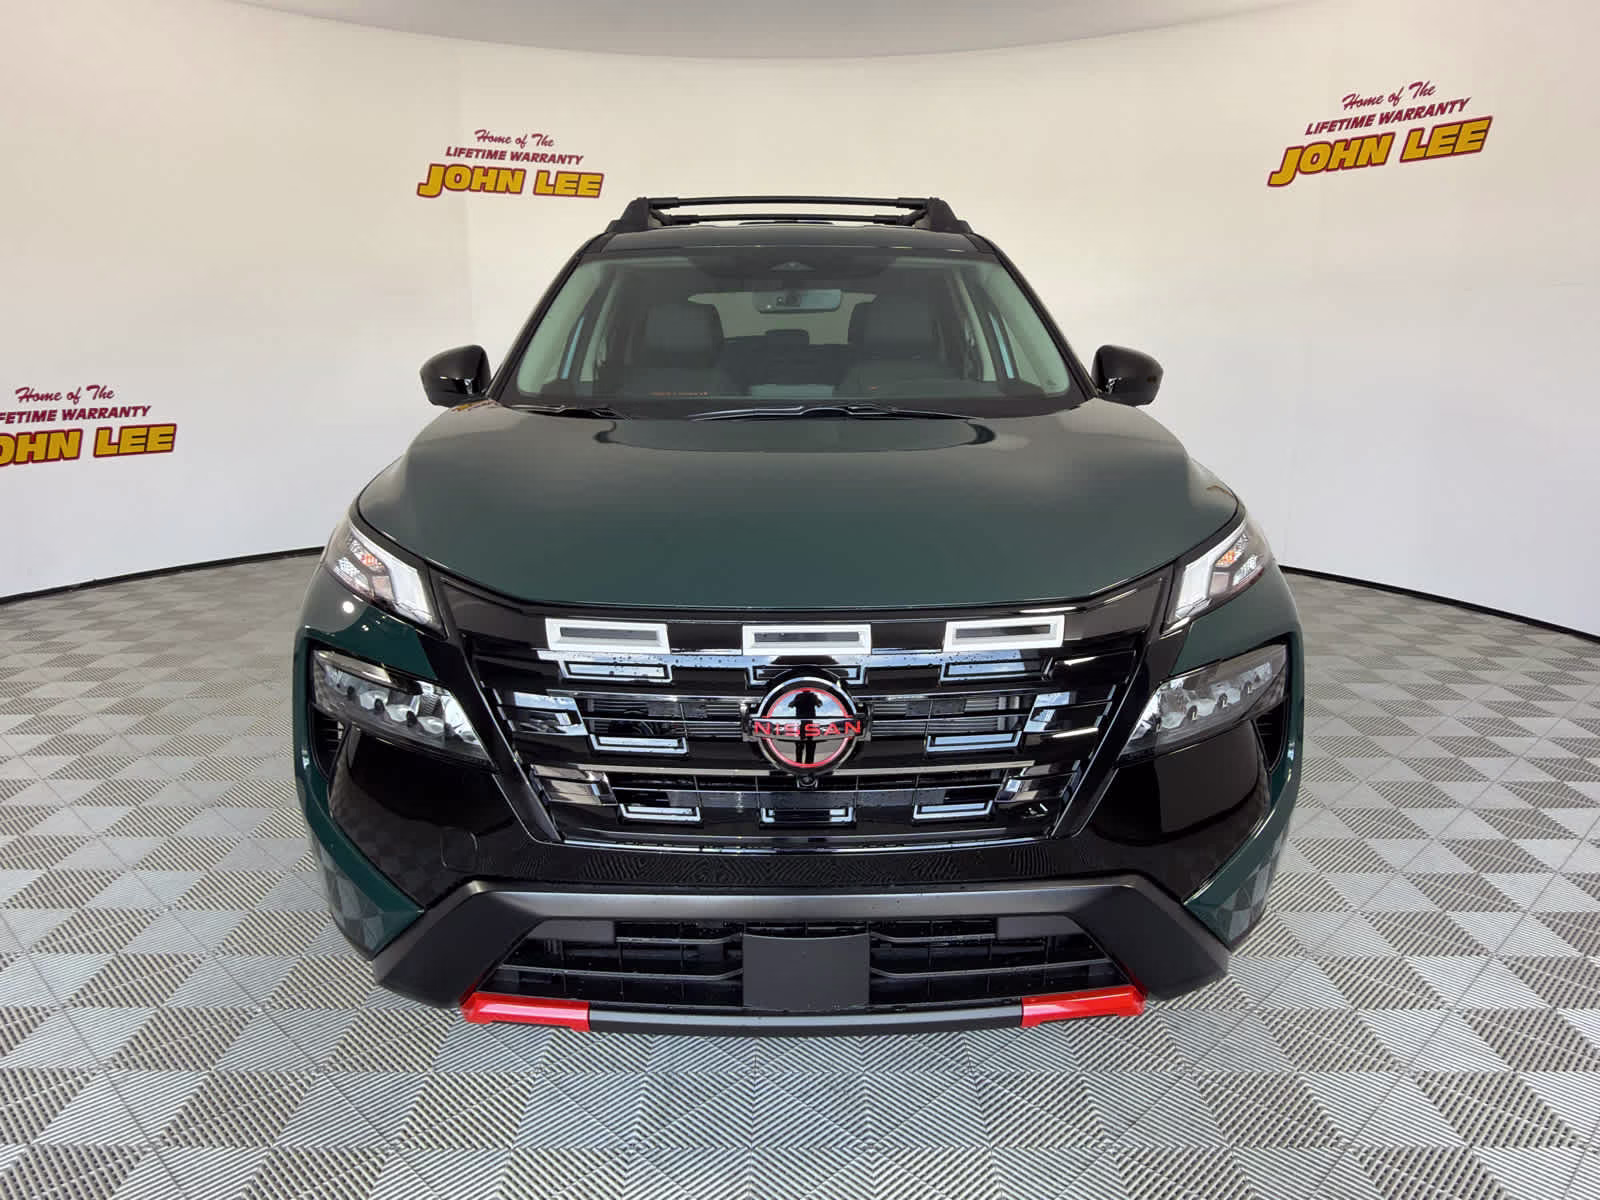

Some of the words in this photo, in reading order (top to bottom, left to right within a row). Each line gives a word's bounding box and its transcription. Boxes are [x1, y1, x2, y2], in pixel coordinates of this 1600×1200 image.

[1342, 93, 1384, 110] Home
[1388, 87, 1404, 106] of
[1409, 81, 1436, 99] The
[1305, 114, 1375, 136] LIFETIME
[1379, 97, 1472, 125] WARRANTY
[475, 129, 511, 144] Home
[515, 134, 528, 149] of
[531, 133, 554, 147] The
[446, 146, 507, 160] LIFETIME
[510, 152, 584, 165] WARRANTY
[1267, 132, 1396, 187] JOHN
[1399, 116, 1493, 163] LEE
[416, 163, 527, 198] JOHN
[532, 170, 604, 198] LEE
[15, 387, 62, 403] Home
[67, 387, 81, 405] of
[86, 385, 114, 400] The
[62, 405, 151, 421] WARRANTY
[93, 423, 177, 458] LEE
[753, 719, 861, 737] NISSAN
